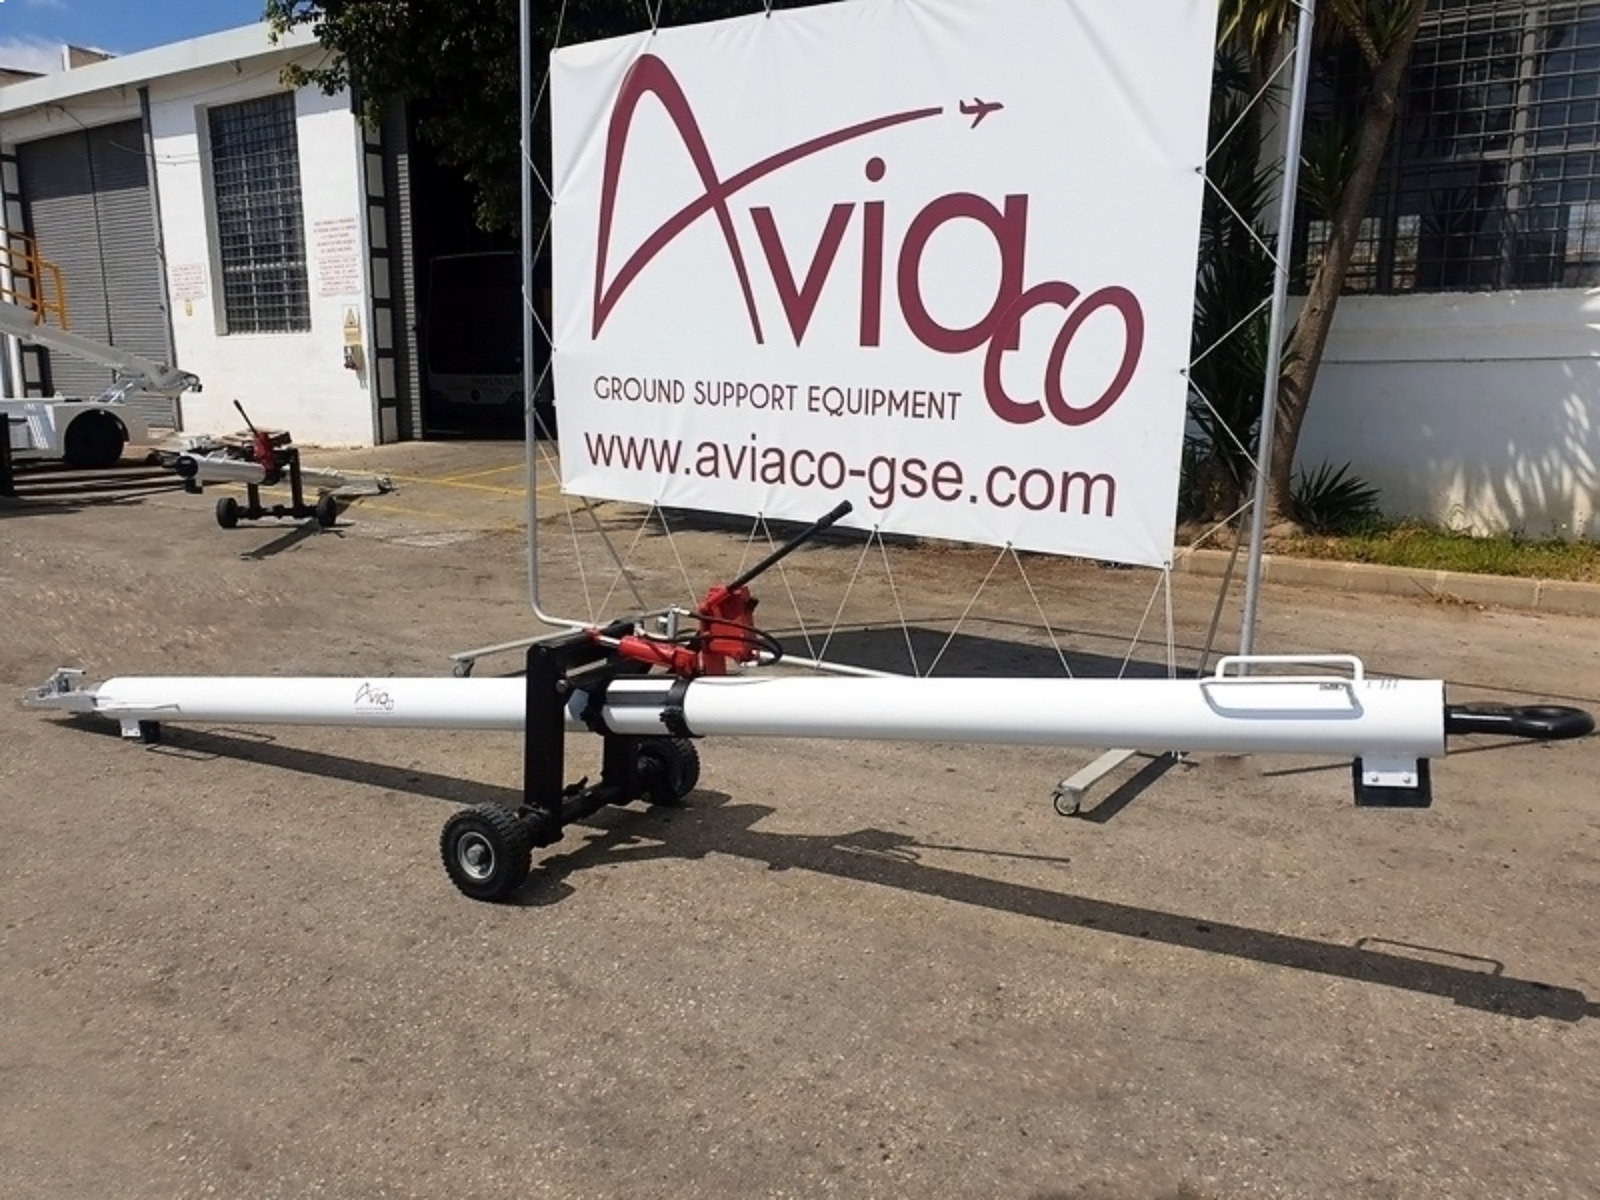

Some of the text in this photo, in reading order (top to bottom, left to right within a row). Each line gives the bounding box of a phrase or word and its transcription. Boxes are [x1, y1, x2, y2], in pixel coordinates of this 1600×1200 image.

[593, 376, 962, 421] GROUND SUPPORT EQUIPMENT
[584, 432, 1117, 517] www.aviaco-gse.com
